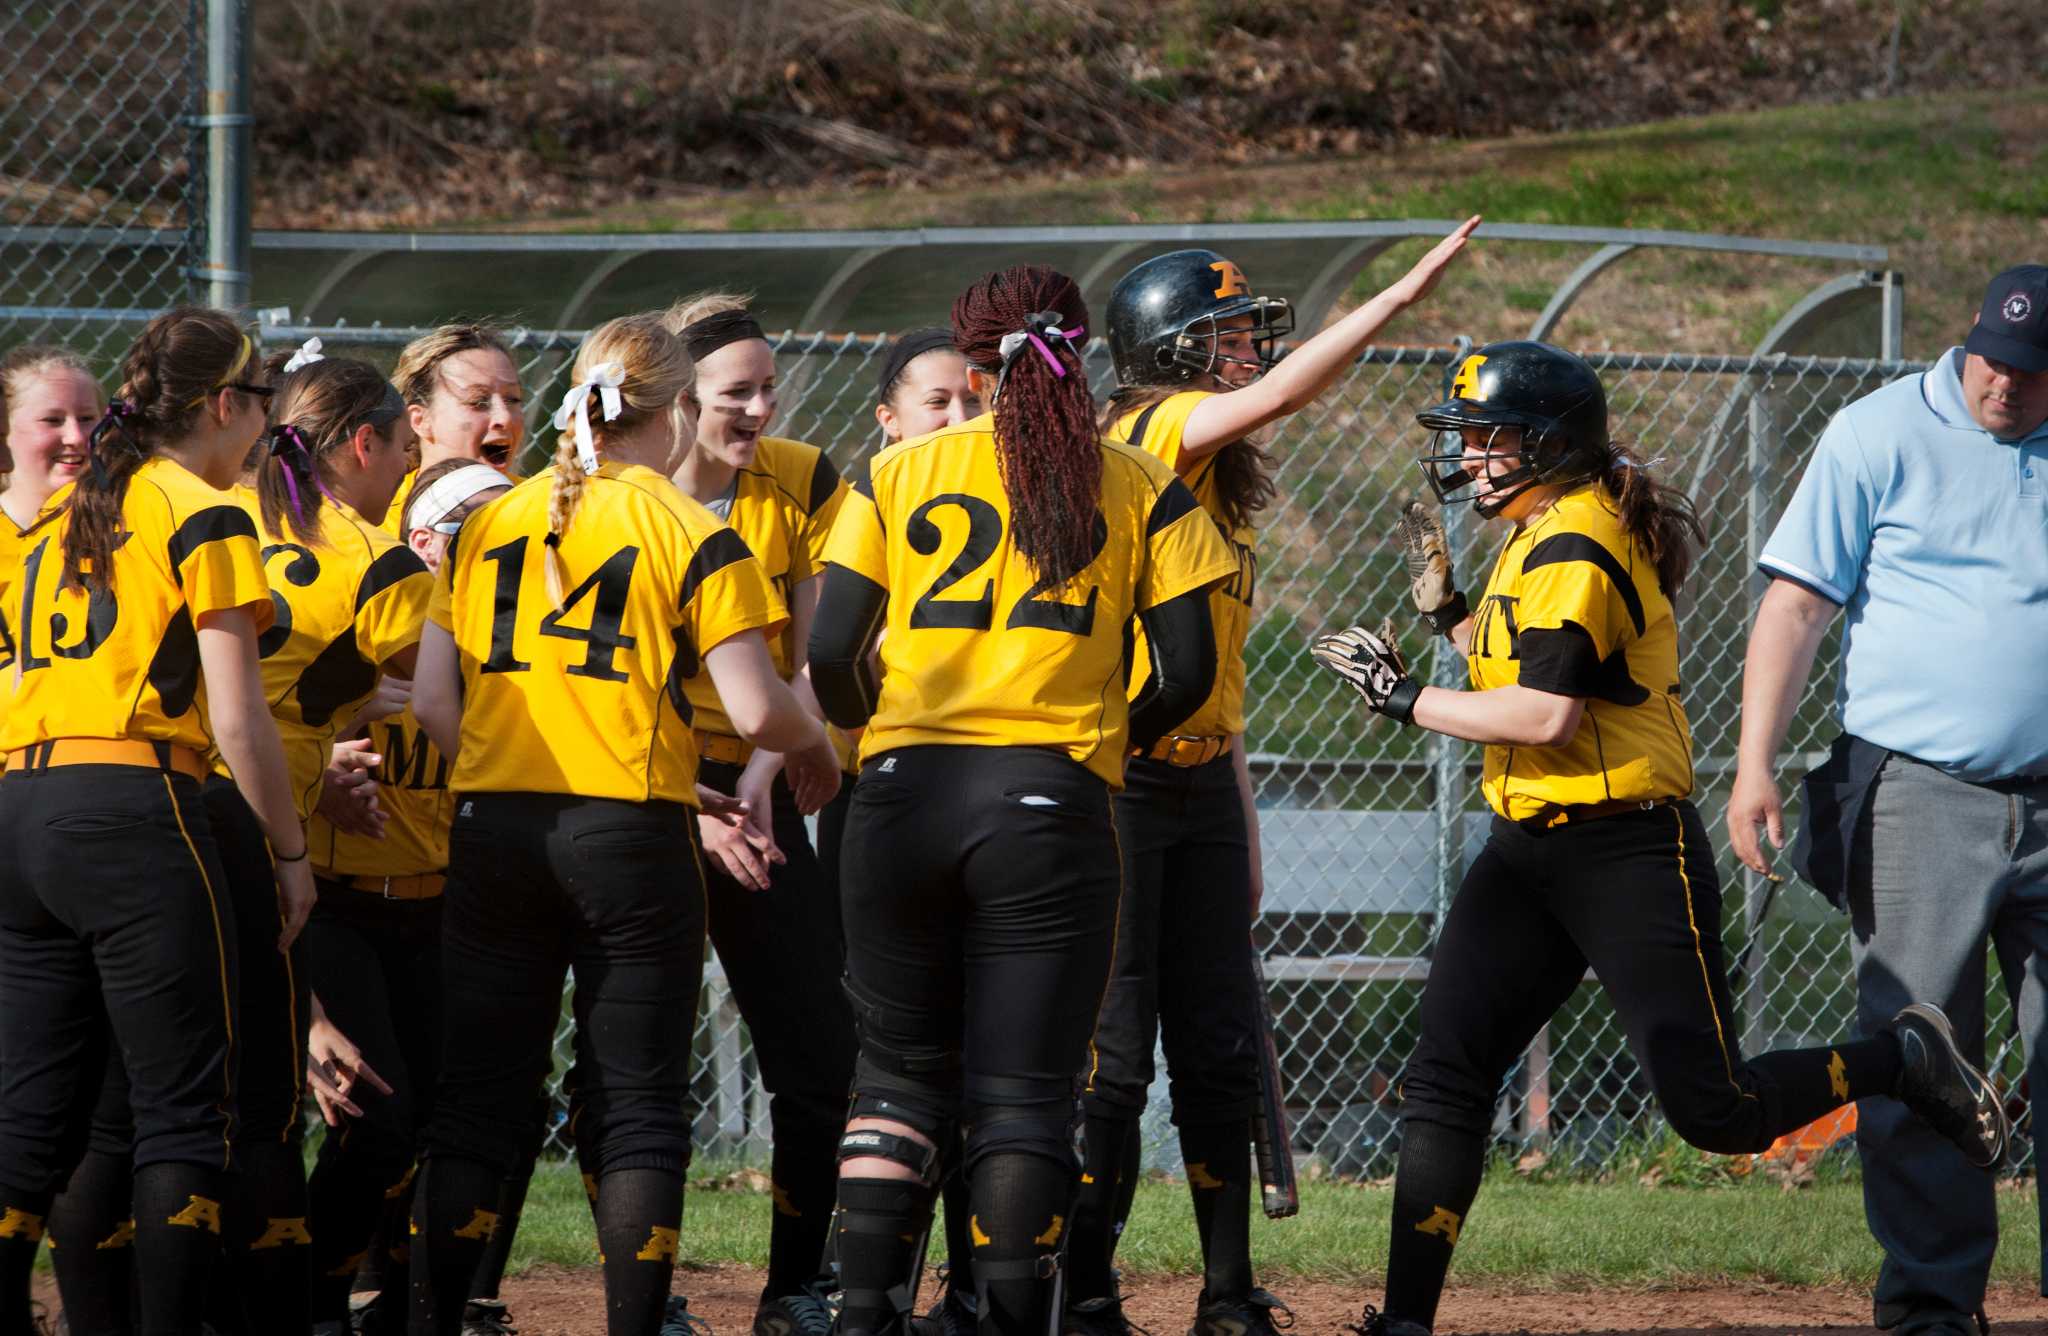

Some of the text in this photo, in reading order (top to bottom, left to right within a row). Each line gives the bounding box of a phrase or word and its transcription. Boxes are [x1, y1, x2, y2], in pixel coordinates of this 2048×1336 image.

[1448, 354, 1489, 402] A
[21, 530, 134, 673] 15
[480, 535, 640, 684] 14
[906, 493, 1108, 637] 22
